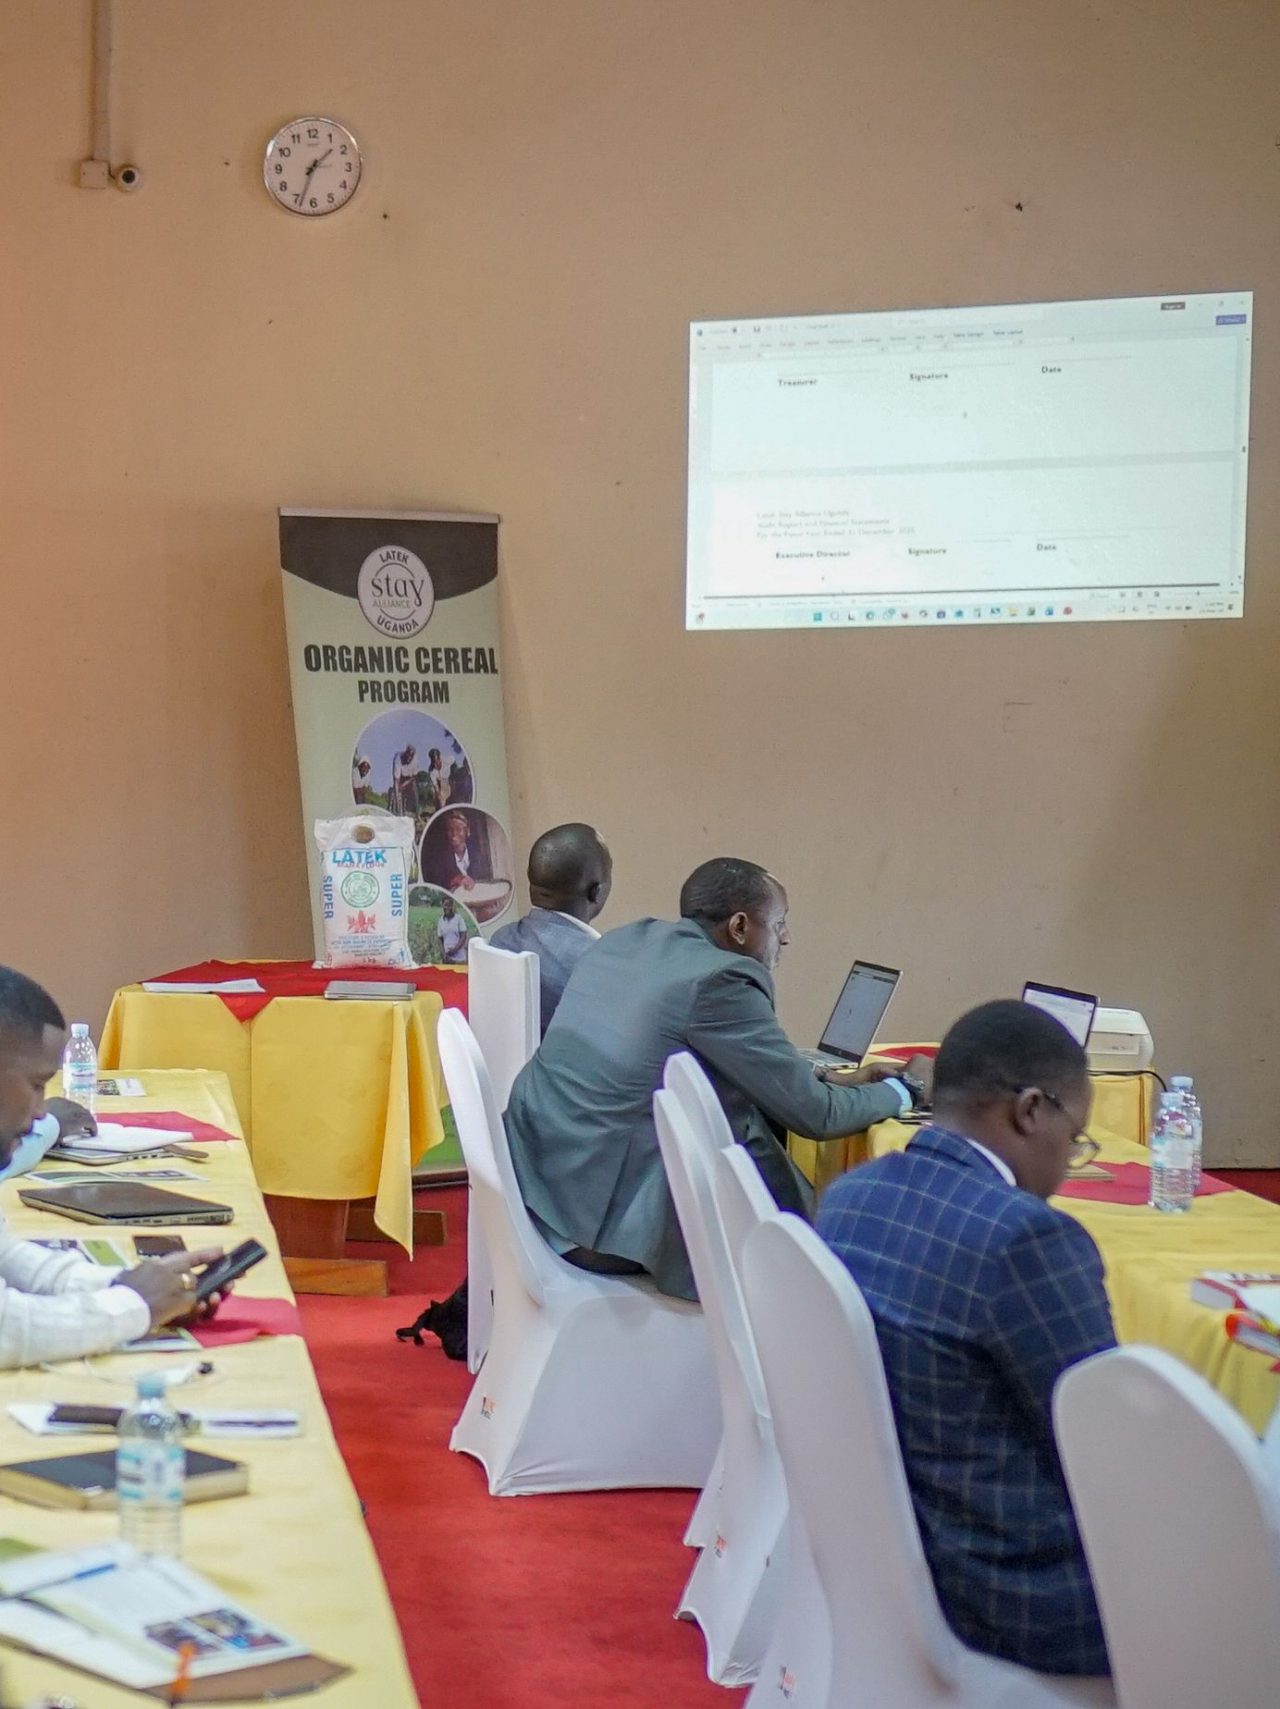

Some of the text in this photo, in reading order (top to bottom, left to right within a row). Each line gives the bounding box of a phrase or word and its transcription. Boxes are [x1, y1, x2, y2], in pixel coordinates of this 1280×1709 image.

[291, 134, 301, 144] 11
[306, 129, 319, 139] 12
[328, 133, 333, 143] 1
[278, 146, 291, 158] 10
[340, 145, 348, 155] 2
[275, 164, 282, 174] 9
[345, 162, 352, 172] 3
[280, 182, 288, 192] 8
[339, 181, 347, 190] 4
[292, 194, 300, 204] 7
[310, 198, 317, 208] 6
[327, 193, 335, 203] 5
[1042, 366, 1061, 374] Date
[910, 372, 948, 382] Signature
[908, 547, 947, 557] Signature
[1036, 543, 1057, 552] Date
[379, 549, 410, 564] LATEK
[371, 573, 424, 607] stay
[372, 600, 411, 608] ALLIANCE
[377, 615, 419, 634] UGANDA
[304, 643, 498, 674] ORGANIC CEREAL
[358, 680, 450, 703] PROGRAM
[332, 849, 387, 864] LATEK
[323, 876, 334, 919] SUPER
[390, 874, 403, 916] SUPER
